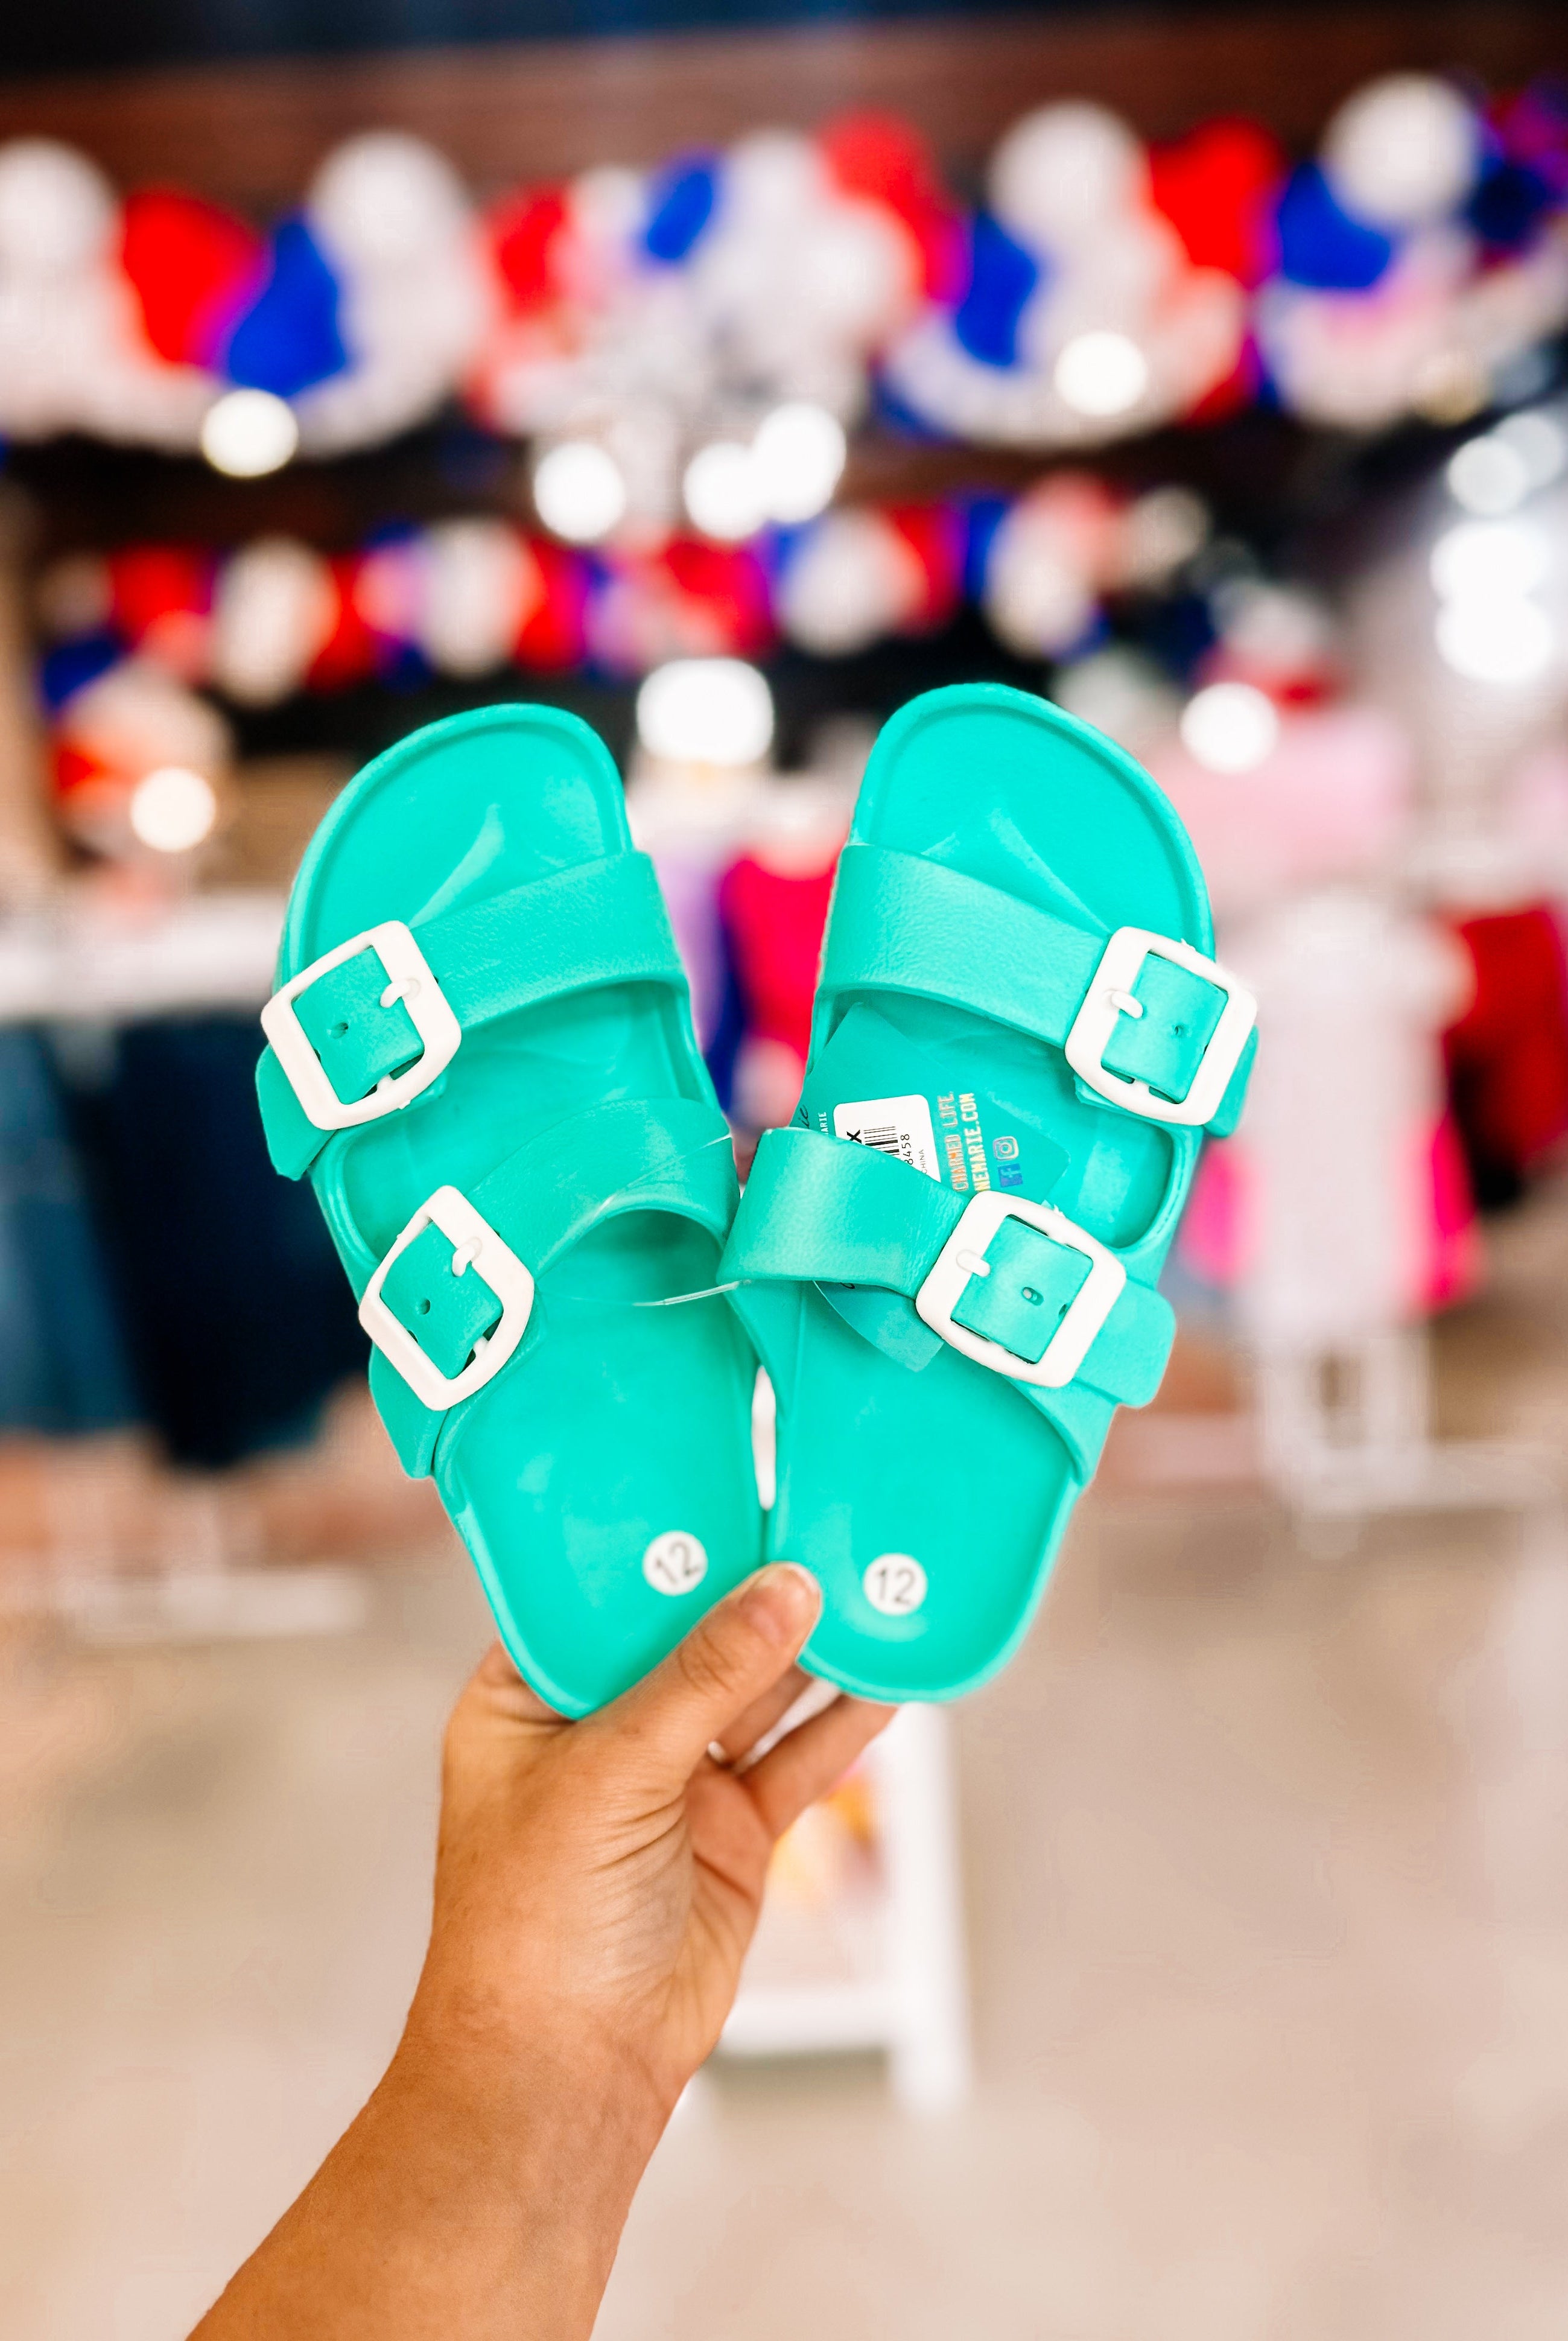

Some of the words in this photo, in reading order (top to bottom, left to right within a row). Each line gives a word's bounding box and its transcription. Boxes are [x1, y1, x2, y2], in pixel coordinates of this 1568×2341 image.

[818, 1111, 829, 1134] ARIE
[945, 1134, 969, 1192] CHARMED
[655, 1540, 701, 1584] 12
[876, 1566, 915, 1605] 12
